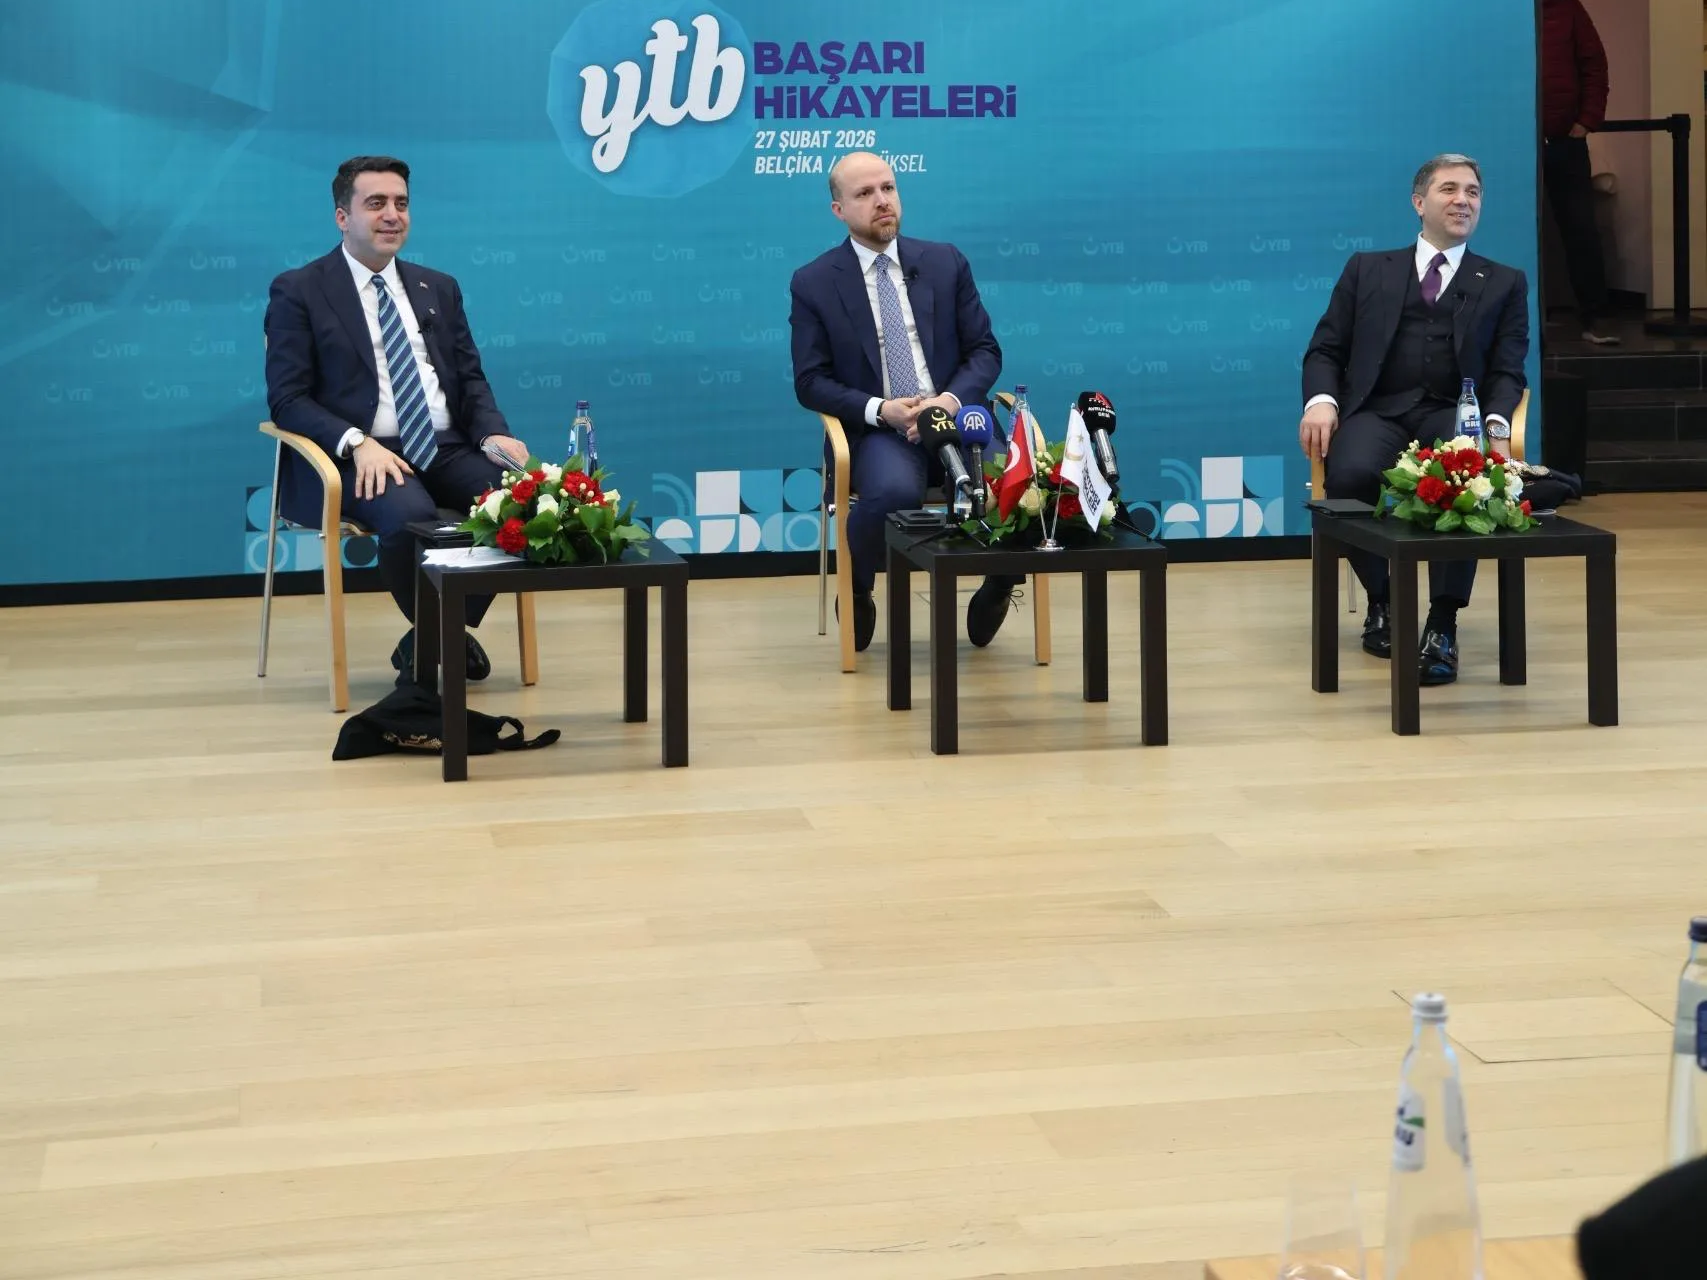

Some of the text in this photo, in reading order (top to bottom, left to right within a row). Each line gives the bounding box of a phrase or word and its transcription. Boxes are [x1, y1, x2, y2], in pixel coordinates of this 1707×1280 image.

[753, 40, 926, 85] BAŞARI
[579, 14, 746, 174] ytb
[755, 129, 876, 153] 27 ŞUBAT 2026
[754, 150, 823, 178] BELÇİKA
[931, 420, 956, 431] YTB
[964, 415, 986, 431] AA
